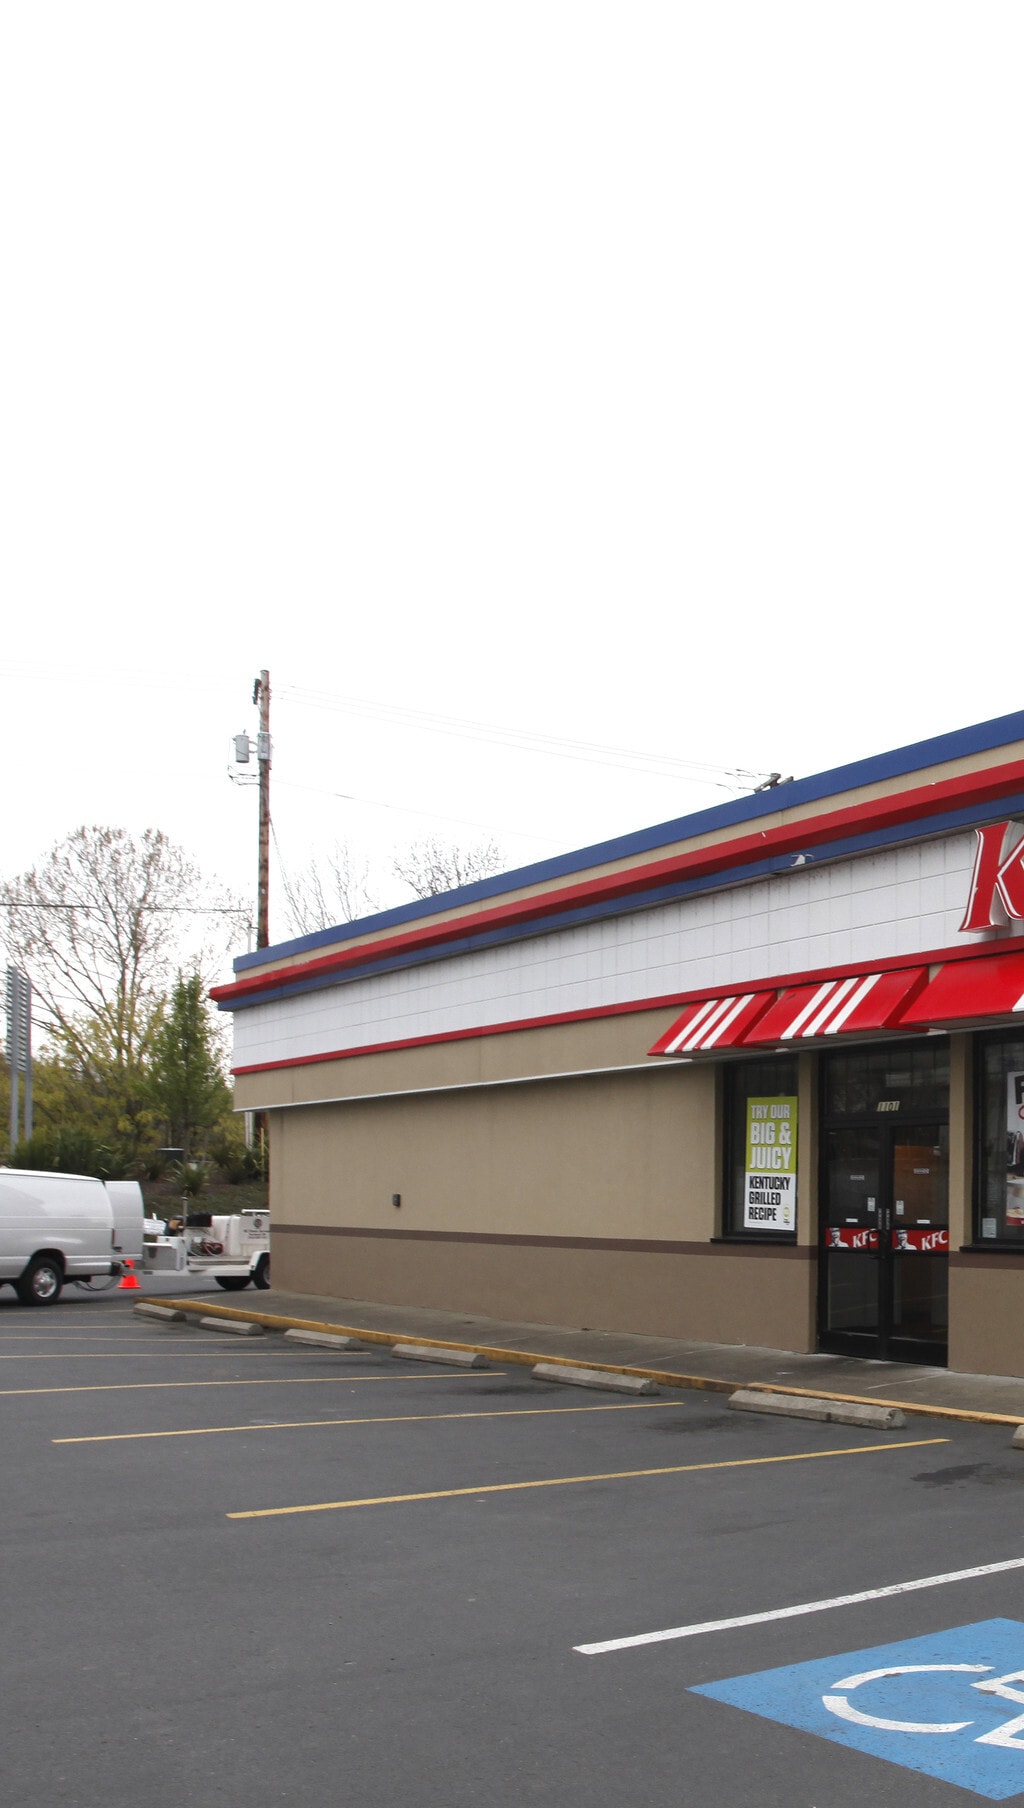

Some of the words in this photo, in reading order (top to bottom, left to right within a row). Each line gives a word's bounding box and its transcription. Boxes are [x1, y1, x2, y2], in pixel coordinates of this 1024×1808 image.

[751, 1105, 768, 1119] TRY
[770, 1104, 790, 1118] OUR
[750, 1122, 776, 1144] BIG
[779, 1121, 791, 1145] &
[749, 1146, 792, 1169] JUICY
[749, 1176, 791, 1190] KENTUCKY
[749, 1191, 781, 1206] GRILLED
[748, 1206, 777, 1221] RECIPE
[852, 1228, 877, 1249] KFC
[921, 1230, 948, 1250] KFC
